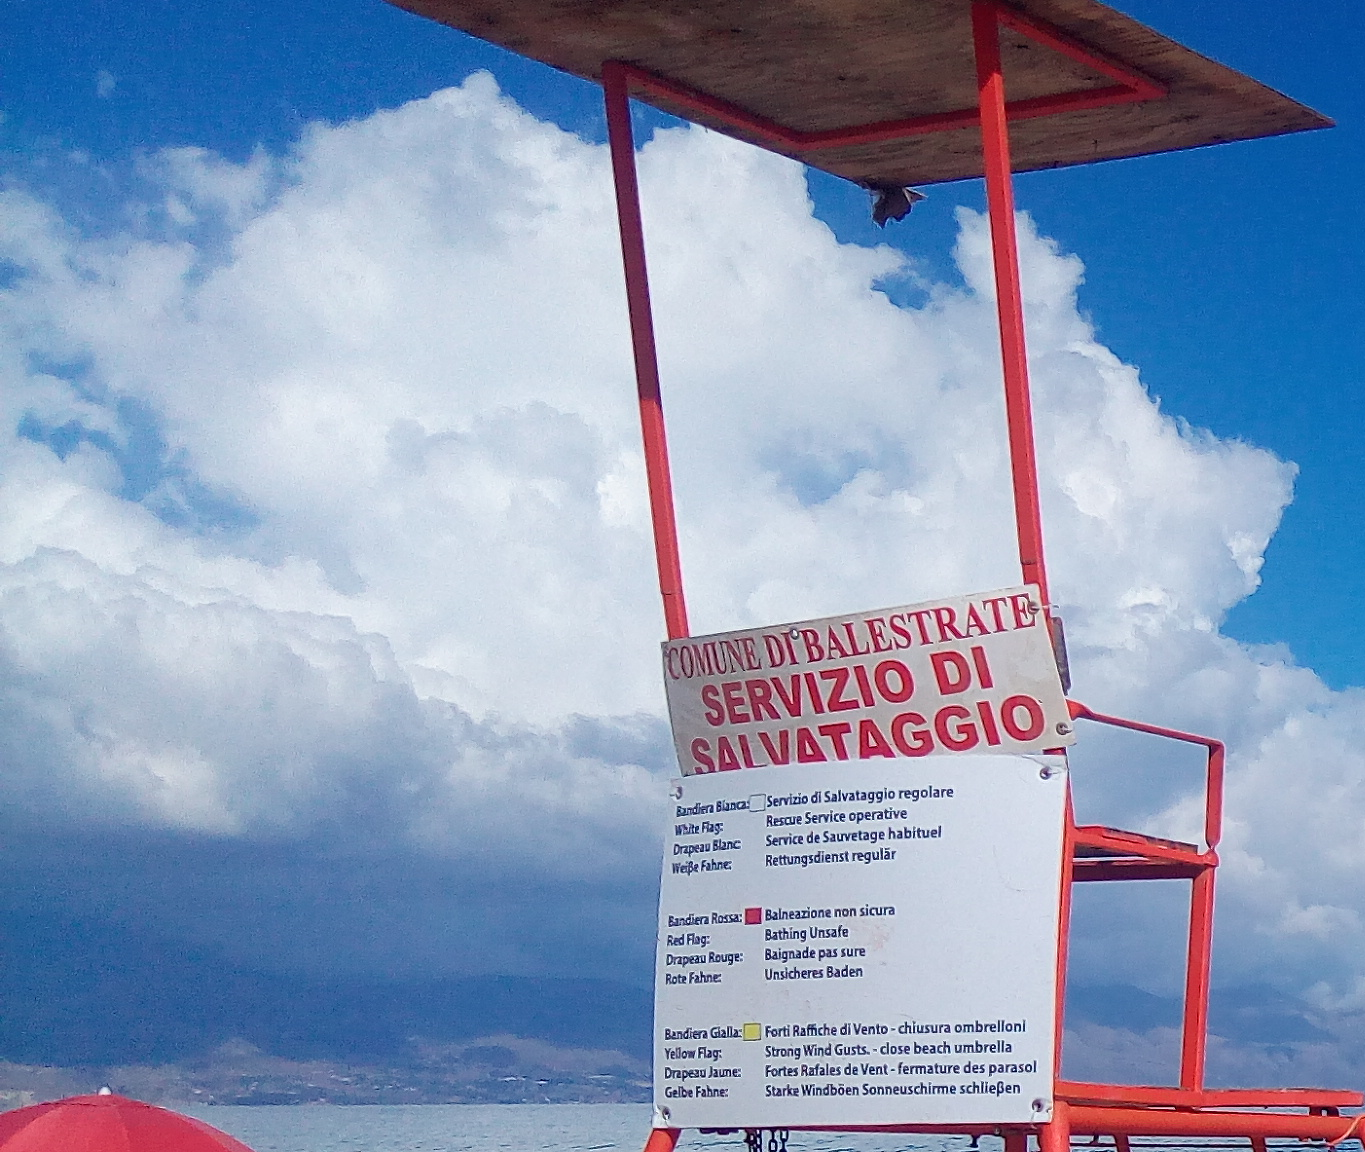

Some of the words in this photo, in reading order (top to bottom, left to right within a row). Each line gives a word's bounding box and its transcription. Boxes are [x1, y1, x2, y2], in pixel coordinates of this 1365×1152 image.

[668, 637, 762, 680] COMUNE
[762, 631, 799, 668] DI
[800, 593, 1036, 663] BALESTRATE
[701, 659, 914, 726] SERVIZIO
[930, 645, 993, 695] DI
[690, 695, 1045, 775] SALVATAGGIO
[766, 792, 808, 808] Servizio
[811, 791, 821, 804] di
[824, 787, 895, 804] Salvataggio
[898, 785, 954, 801] regolare
[676, 802, 714, 817] Bandiera
[716, 799, 750, 812] Bianca:
[766, 814, 802, 827] Rescue
[805, 810, 846, 824] Service
[849, 807, 908, 824] operative
[675, 823, 700, 836] White
[701, 821, 724, 835] Flag:
[765, 832, 804, 846] Service
[807, 831, 820, 844] de
[823, 829, 885, 844] Sauvetage
[888, 825, 942, 840] habituel
[673, 843, 710, 857] Drapeau
[712, 838, 741, 851] Blanc:
[765, 850, 850, 867] Rettungsdienst
[852, 847, 897, 864] regulär
[668, 913, 709, 927] Bandiera
[711, 912, 742, 924] Rossa:
[765, 906, 832, 921] Balneazione
[834, 907, 857, 918] non
[859, 904, 896, 917] sicura
[667, 933, 685, 946] Red
[687, 933, 710, 948] Flag:
[764, 927, 807, 943] Bathing
[809, 925, 849, 939] Unsafe
[666, 953, 706, 968] Drapeau
[708, 951, 744, 966] Rouge:
[764, 946, 816, 963] Baignade
[818, 948, 838, 961] pas
[840, 947, 866, 958] sure
[665, 972, 687, 985] Rote
[688, 971, 722, 984] Fahne:
[764, 966, 824, 980] Unsicheres
[826, 964, 863, 979] Baden
[664, 1027, 708, 1040] Bandiera
[710, 1026, 743, 1039] Gialla:
[765, 1024, 790, 1038] Forti
[792, 1023, 837, 1037] Raffiche
[840, 1023, 851, 1036] di
[852, 1023, 889, 1036] Vento
[898, 1021, 951, 1035] chiusura
[954, 1019, 1026, 1033] ombrelloni
[664, 1047, 696, 1060] Yellow
[697, 1046, 722, 1061] Flag:
[765, 1045, 801, 1060] Strong
[802, 1044, 832, 1057] Wind
[879, 1042, 911, 1055] close
[913, 1041, 951, 1054] beach
[954, 1040, 1013, 1053] umbrella
[664, 1066, 707, 1082] Drapeau
[708, 1065, 742, 1078] Jaune:
[765, 1064, 799, 1078] Fortes
[800, 1063, 841, 1077] Rafales
[843, 1063, 858, 1076] de
[859, 1063, 888, 1075] Vent
[897, 1061, 961, 1075] fermature
[963, 1060, 985, 1074] des
[988, 1060, 1037, 1077] parasol
[664, 1085, 694, 1098] Gelbe
[695, 1084, 729, 1098] Fahne:
[765, 1084, 800, 1097] Starke
[801, 1083, 860, 1096] Windböen
[959, 1081, 1021, 1097] schließen
